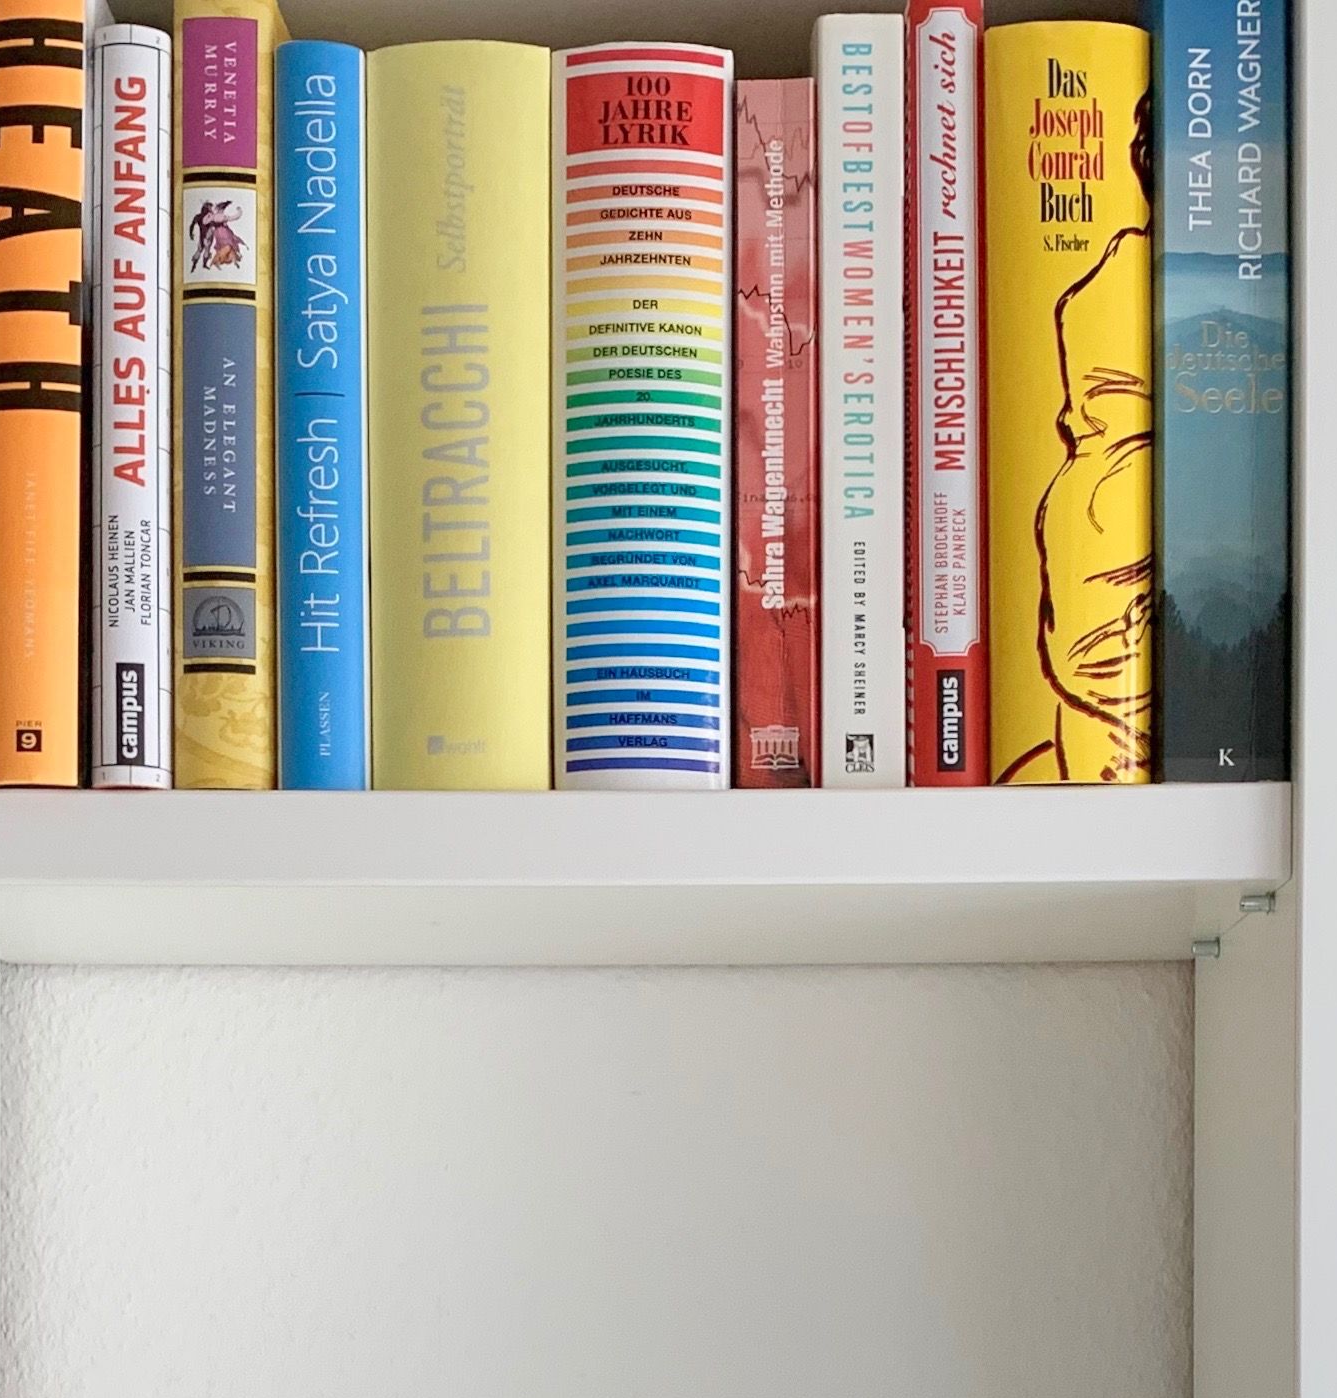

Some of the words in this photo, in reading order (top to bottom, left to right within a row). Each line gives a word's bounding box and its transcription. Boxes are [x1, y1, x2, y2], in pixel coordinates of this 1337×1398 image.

[626, 76, 670, 97] 100
[1048, 59, 1087, 99] Das
[1188, 48, 1212, 138] DORN
[1237, 0, 1261, 132] WAGNER
[297, 71, 336, 238] Nadella
[597, 100, 693, 124] JAHRE
[601, 123, 690, 146] LYRIK
[1030, 98, 1103, 142] Joseph
[114, 77, 146, 245] ANFANG
[1028, 141, 1104, 182] Conrad
[1040, 184, 1093, 224] Buch
[1189, 151, 1211, 230] THEA
[1238, 143, 1262, 279] RICHARD
[114, 259, 145, 342] AUF
[296, 253, 345, 370] Satya
[934, 231, 965, 471] MENSCHLICHKEIT
[113, 357, 150, 487] ALLES
[761, 378, 784, 548] Wagenknecht
[299, 418, 338, 582] Refresh
[302, 593, 339, 655] Hit
[761, 556, 784, 610] Sahra
[120, 669, 141, 760] campus
[939, 675, 958, 767] campus
